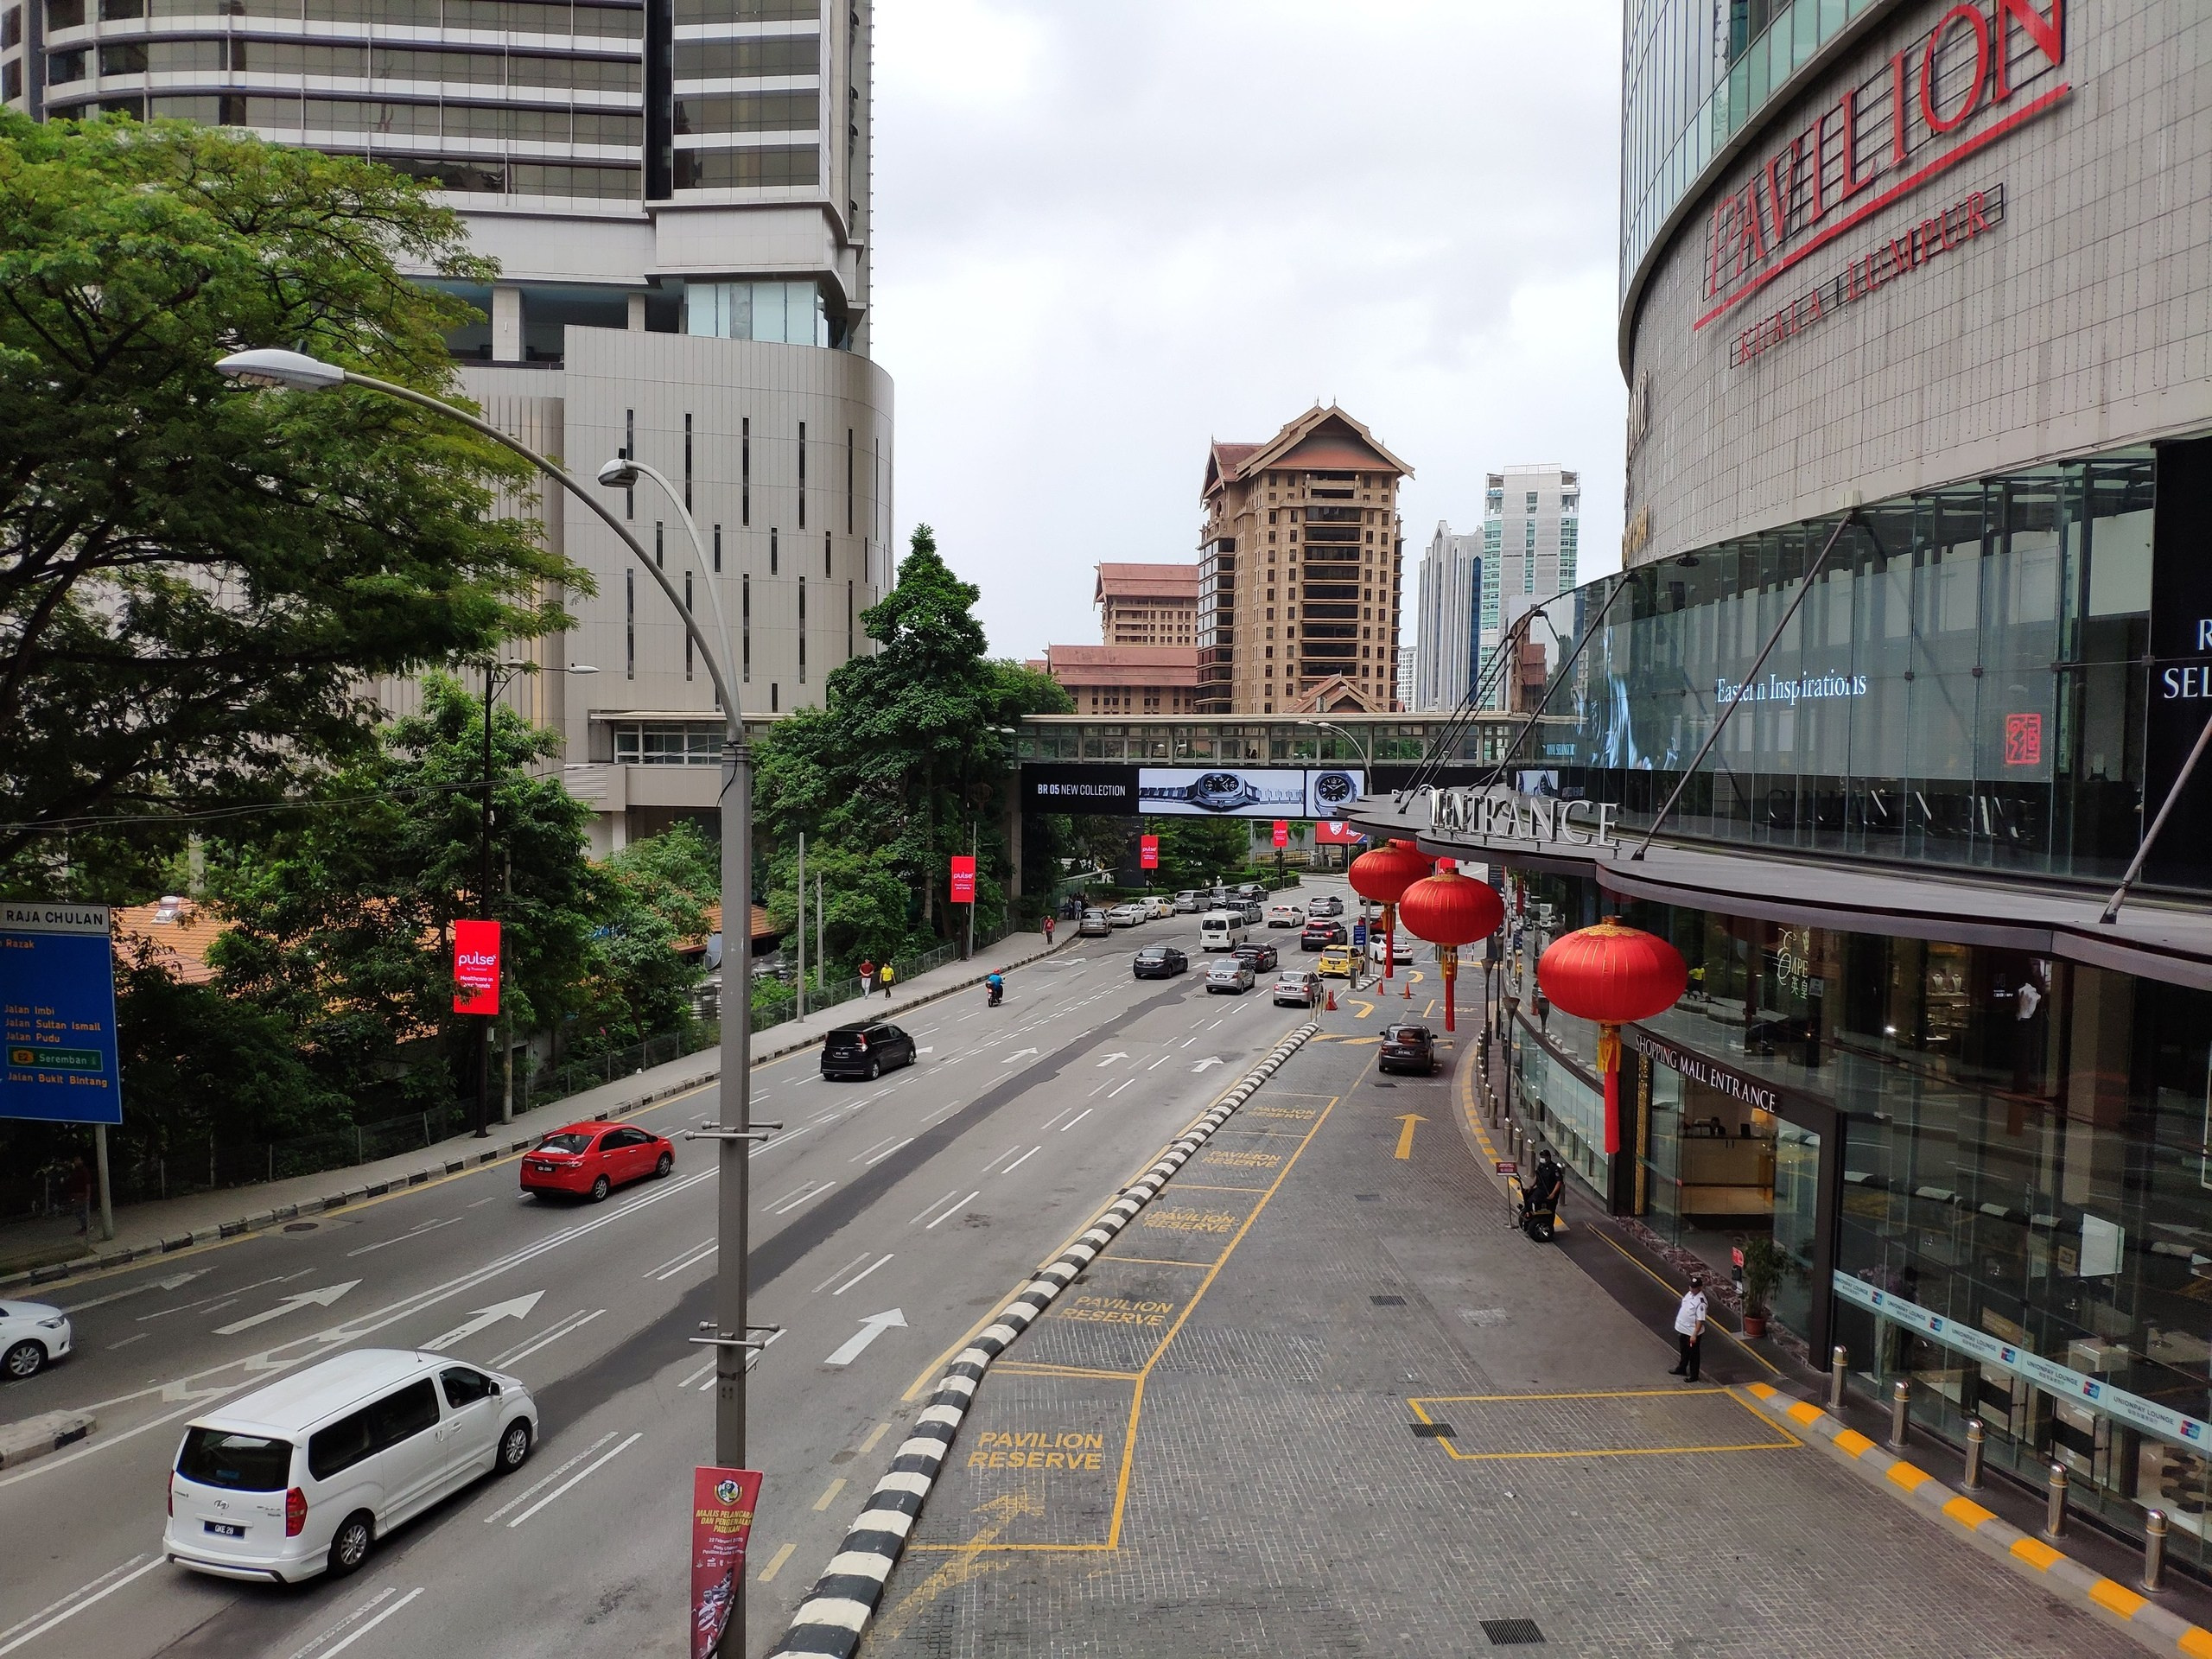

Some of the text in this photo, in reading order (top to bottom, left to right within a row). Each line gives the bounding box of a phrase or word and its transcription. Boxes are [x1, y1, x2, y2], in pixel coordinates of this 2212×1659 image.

[1708, 0, 2063, 298] PAVILION
[1739, 191, 1991, 365] KUALA LUMPUR
[1770, 668, 1867, 706] Inspirations
[1038, 784, 1126, 796] BR 05 NEW COLLECTION
[954, 871, 973, 880] pulse
[6, 910, 103, 925] RAJA CHULAN
[6, 938, 35, 949] Razak
[458, 951, 496, 966] pulse
[4, 1004, 54, 1015] Jalan Imbi
[5, 1019, 101, 1031] Jalan Sultan Ismail
[6, 1032, 60, 1043] Jalan Pudu
[39, 1053, 87, 1065] Seremban
[8, 1072, 108, 1088] Jalan Bukit Bintang
[1635, 1034, 1776, 1113] SHOPPING MALL ENTRANCE
[1247, 1111, 1314, 1120] RESERVE
[1253, 1106, 1316, 1115] PAVILION
[1201, 1157, 1278, 1167] RESERVE
[1210, 1150, 1281, 1161] PAVILION
[1150, 1211, 1236, 1224] PAVILION
[1142, 1219, 1231, 1233] RESERVE
[1073, 1296, 1174, 1313] PAVILION
[1058, 1307, 1166, 1326] RESERVE
[2027, 1360, 2054, 1376] UNIONPAY
[2055, 1372, 2078, 1386] LOUNGE
[2113, 1395, 2146, 1414] UNIONPAY
[2147, 1408, 2174, 1426] LOUNGE
[978, 1432, 1103, 1449] PAVILION
[967, 1452, 1103, 1470] RESERVE
[713, 1525, 741, 1534] PASUKAN
